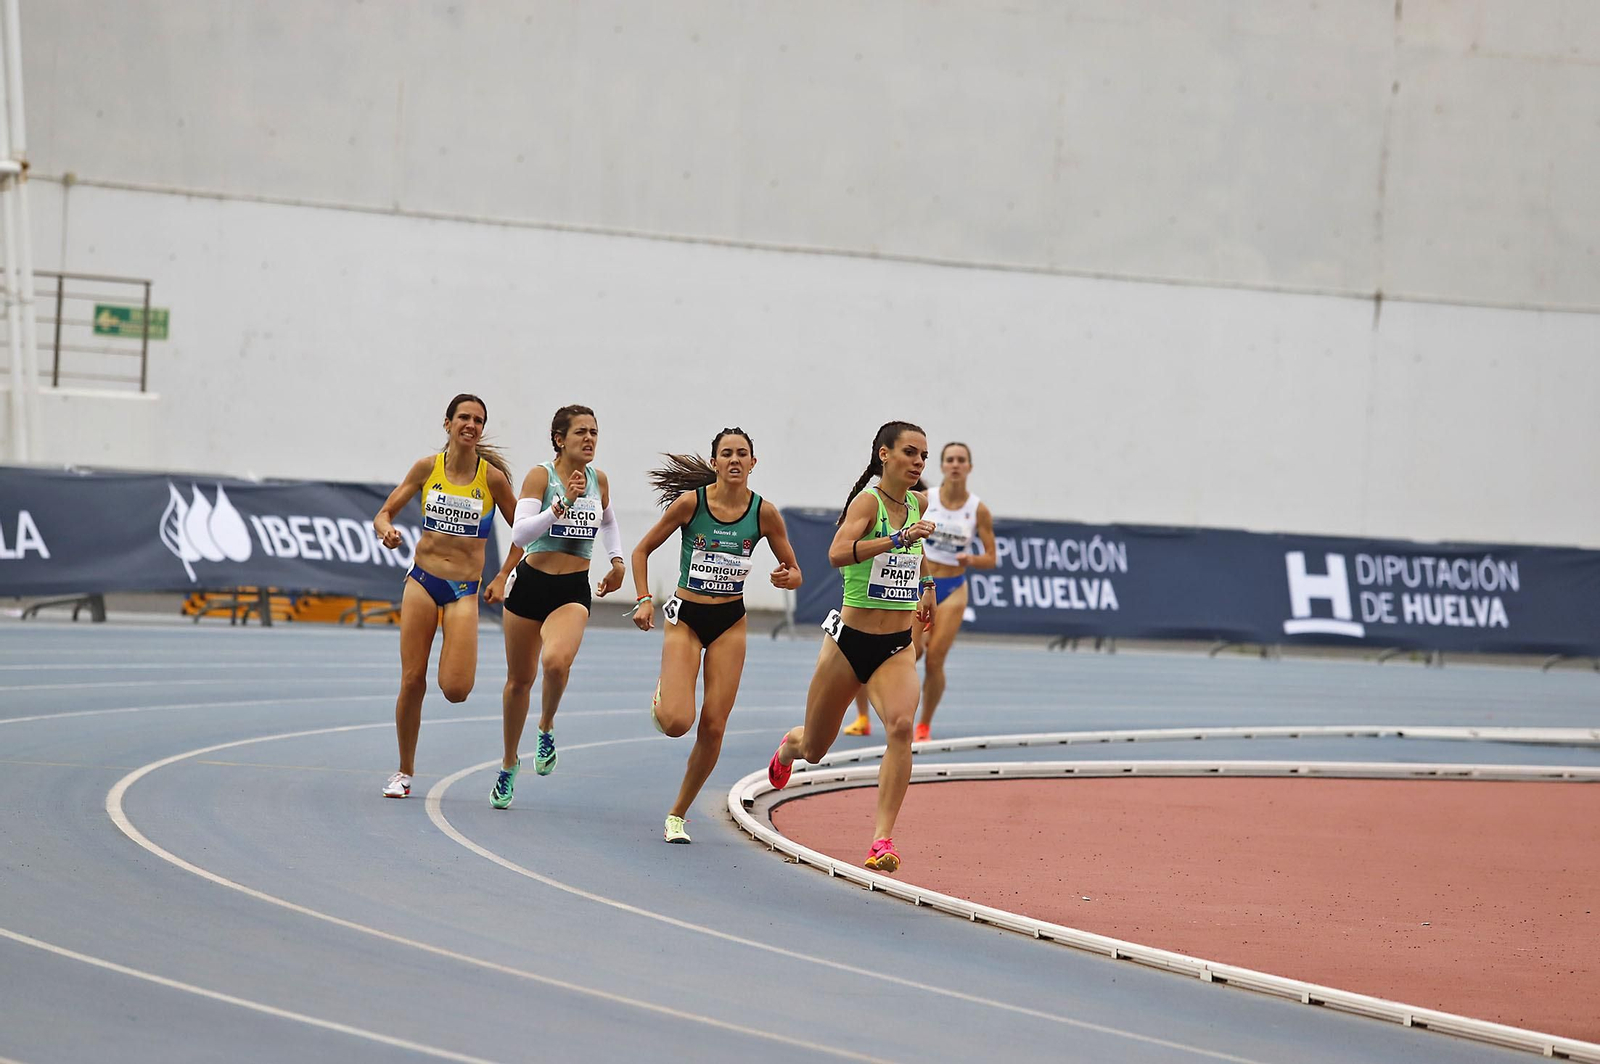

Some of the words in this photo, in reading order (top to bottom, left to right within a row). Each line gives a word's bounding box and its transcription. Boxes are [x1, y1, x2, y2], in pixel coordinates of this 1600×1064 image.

[425, 503, 479, 520] SABORIDO
[564, 510, 596, 521] RECIO
[250, 515, 421, 570] IBERDRO
[967, 534, 1128, 573] DPUTACIÓN
[691, 563, 749, 576] RODRIGUEZ
[1355, 553, 1521, 592] DIPUTACIÓN
[970, 573, 1008, 607] DE
[1011, 575, 1119, 611] HUELVA
[1360, 591, 1398, 624] DE
[1402, 592, 1509, 629] HUELVA
[825, 614, 840, 636] 3
